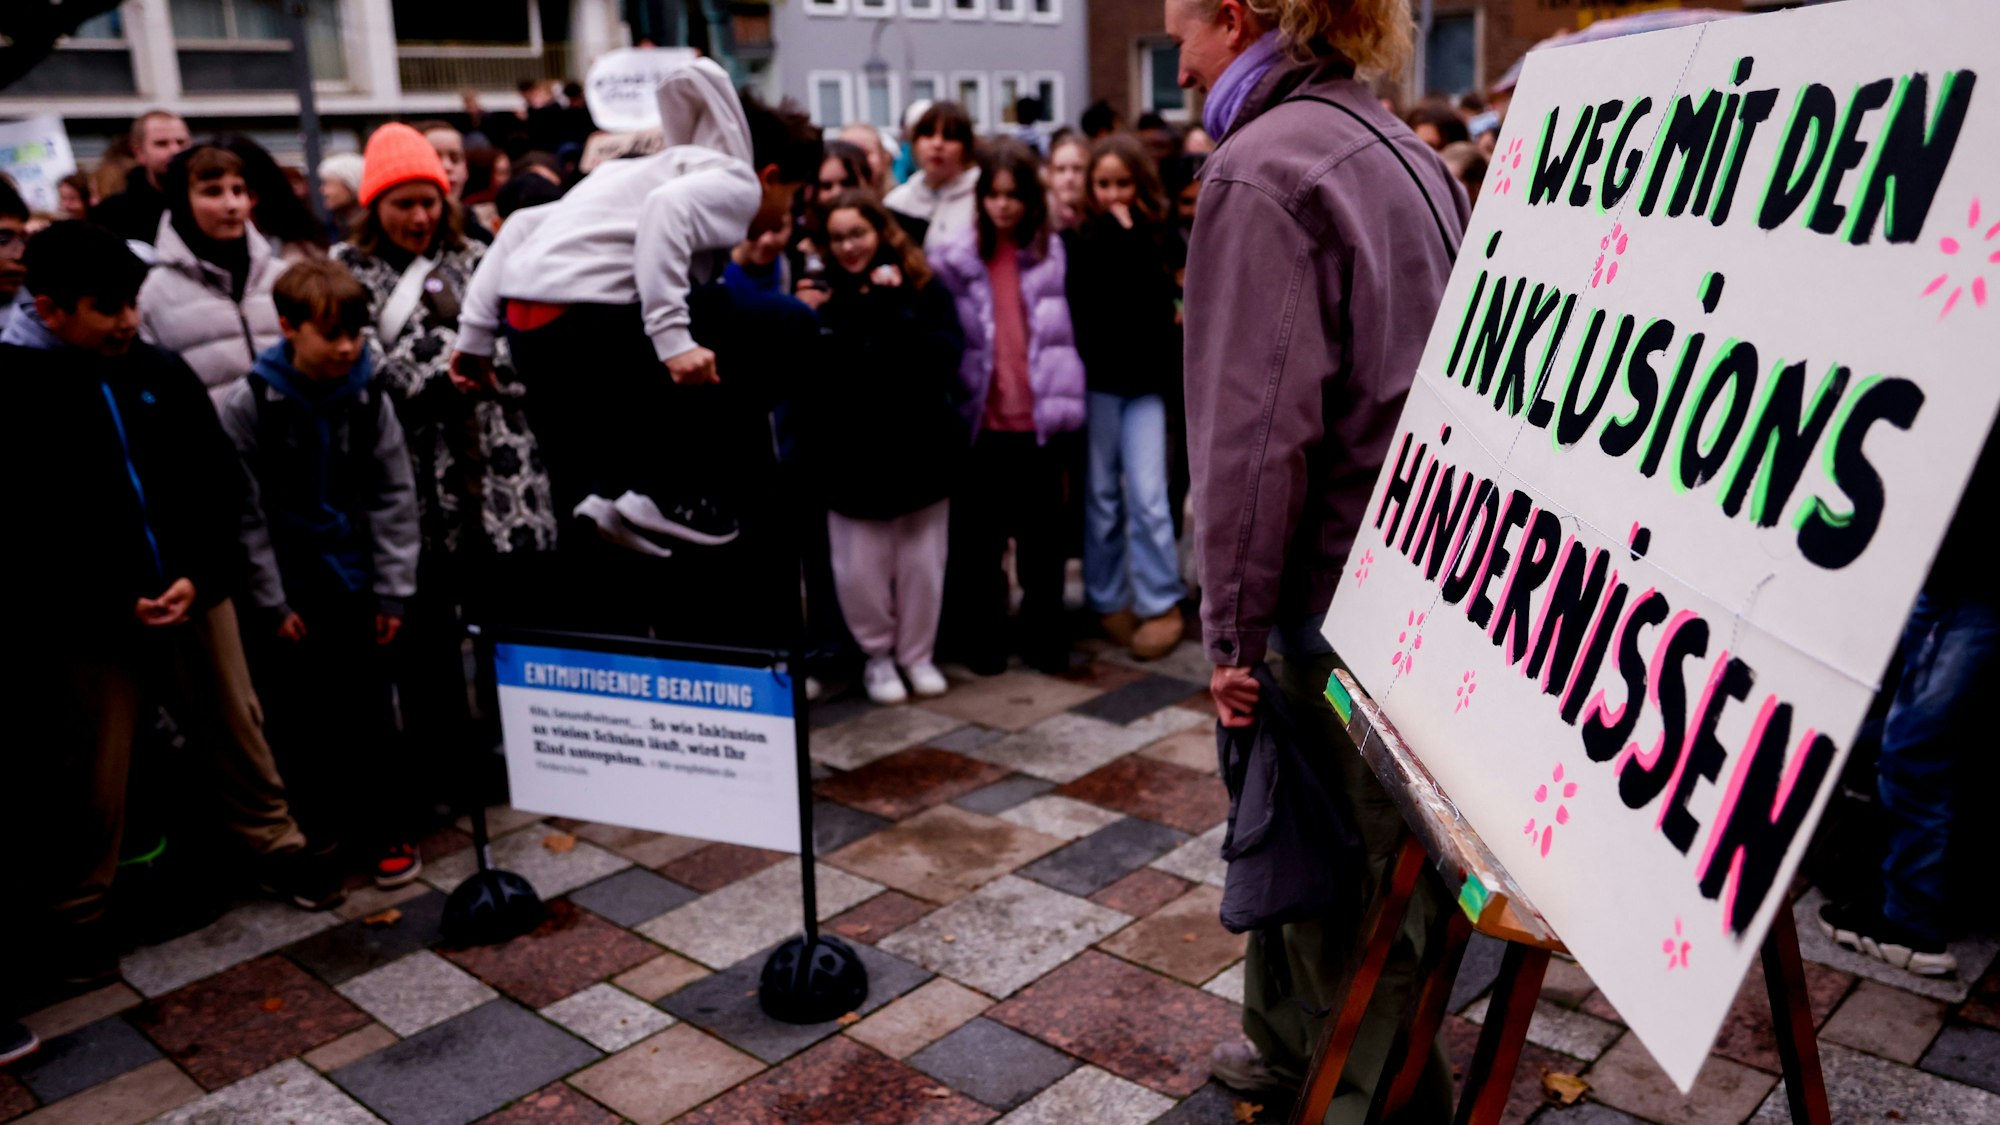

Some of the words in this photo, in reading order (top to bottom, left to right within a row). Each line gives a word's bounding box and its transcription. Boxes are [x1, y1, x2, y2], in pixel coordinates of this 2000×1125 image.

[1527, 96, 1652, 215] WEG
[1754, 69, 1977, 245] DEN
[524, 661, 651, 697] ENTMUTIGENDE
[657, 675, 752, 709] BERATUNG
[551, 726, 589, 740] vielen
[593, 729, 645, 747] Schulen
[687, 743, 720, 758] wird
[723, 745, 746, 760] Ihr
[670, 722, 694, 735] wie
[697, 722, 767, 743] Inklusion
[534, 740, 565, 756] Kind
[567, 747, 646, 767] untergehen.
